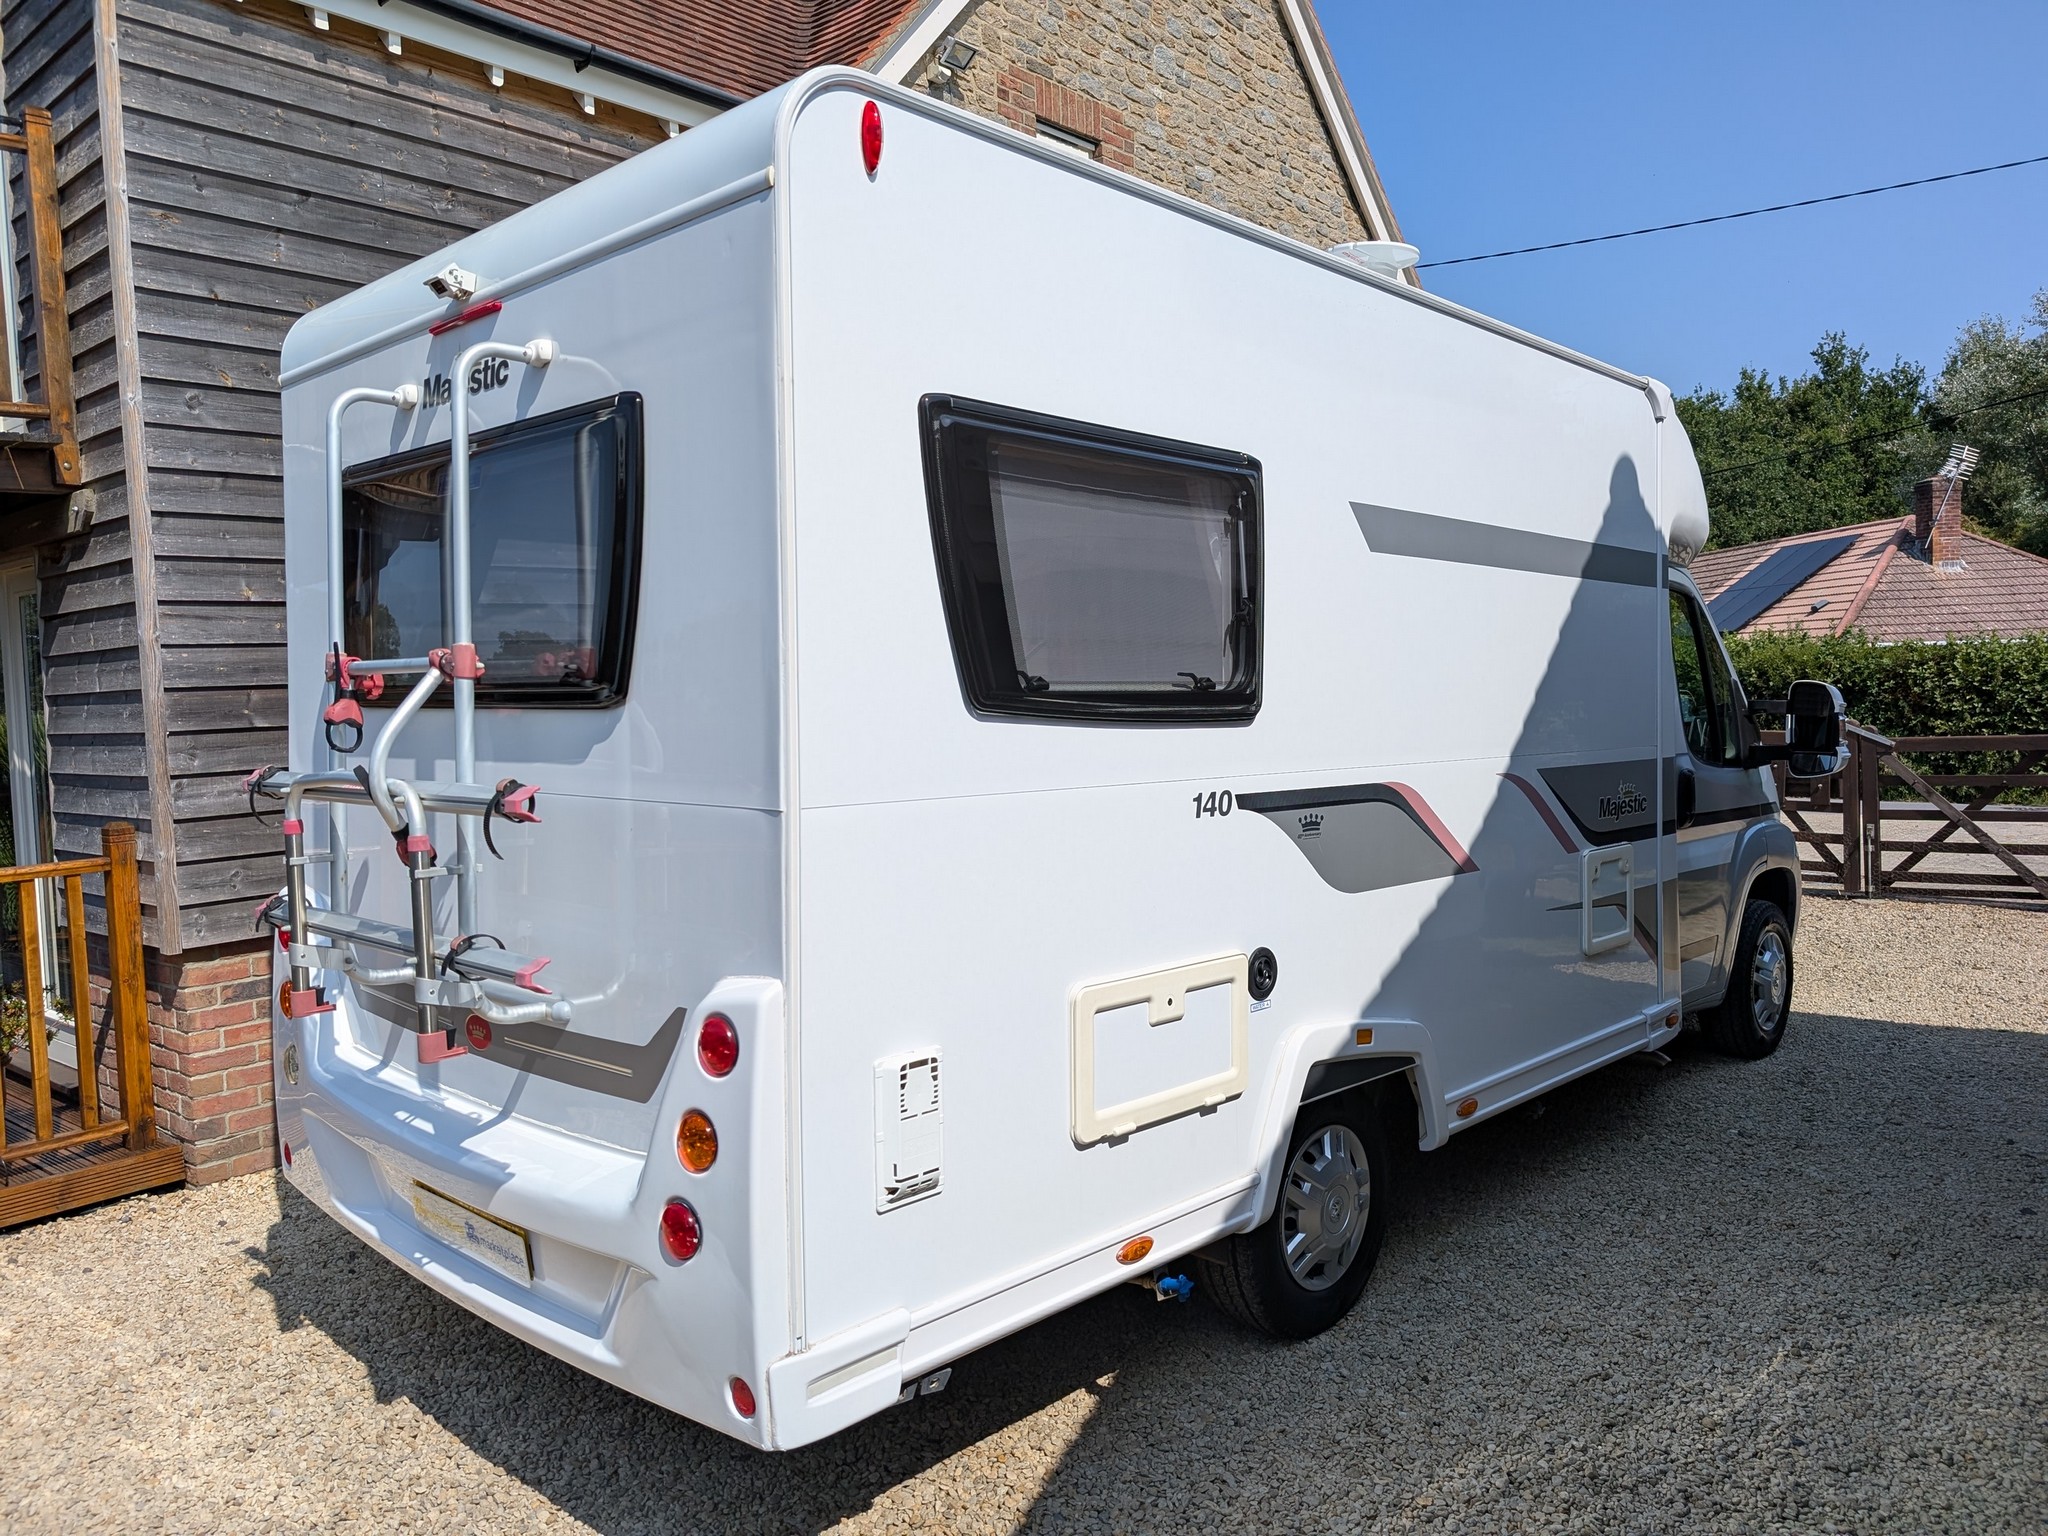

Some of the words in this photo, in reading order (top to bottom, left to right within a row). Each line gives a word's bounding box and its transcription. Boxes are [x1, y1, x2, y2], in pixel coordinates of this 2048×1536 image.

[422, 357, 510, 410] Mastic
[1192, 789, 1233, 819] 140
[1599, 793, 1647, 822] Majestic
